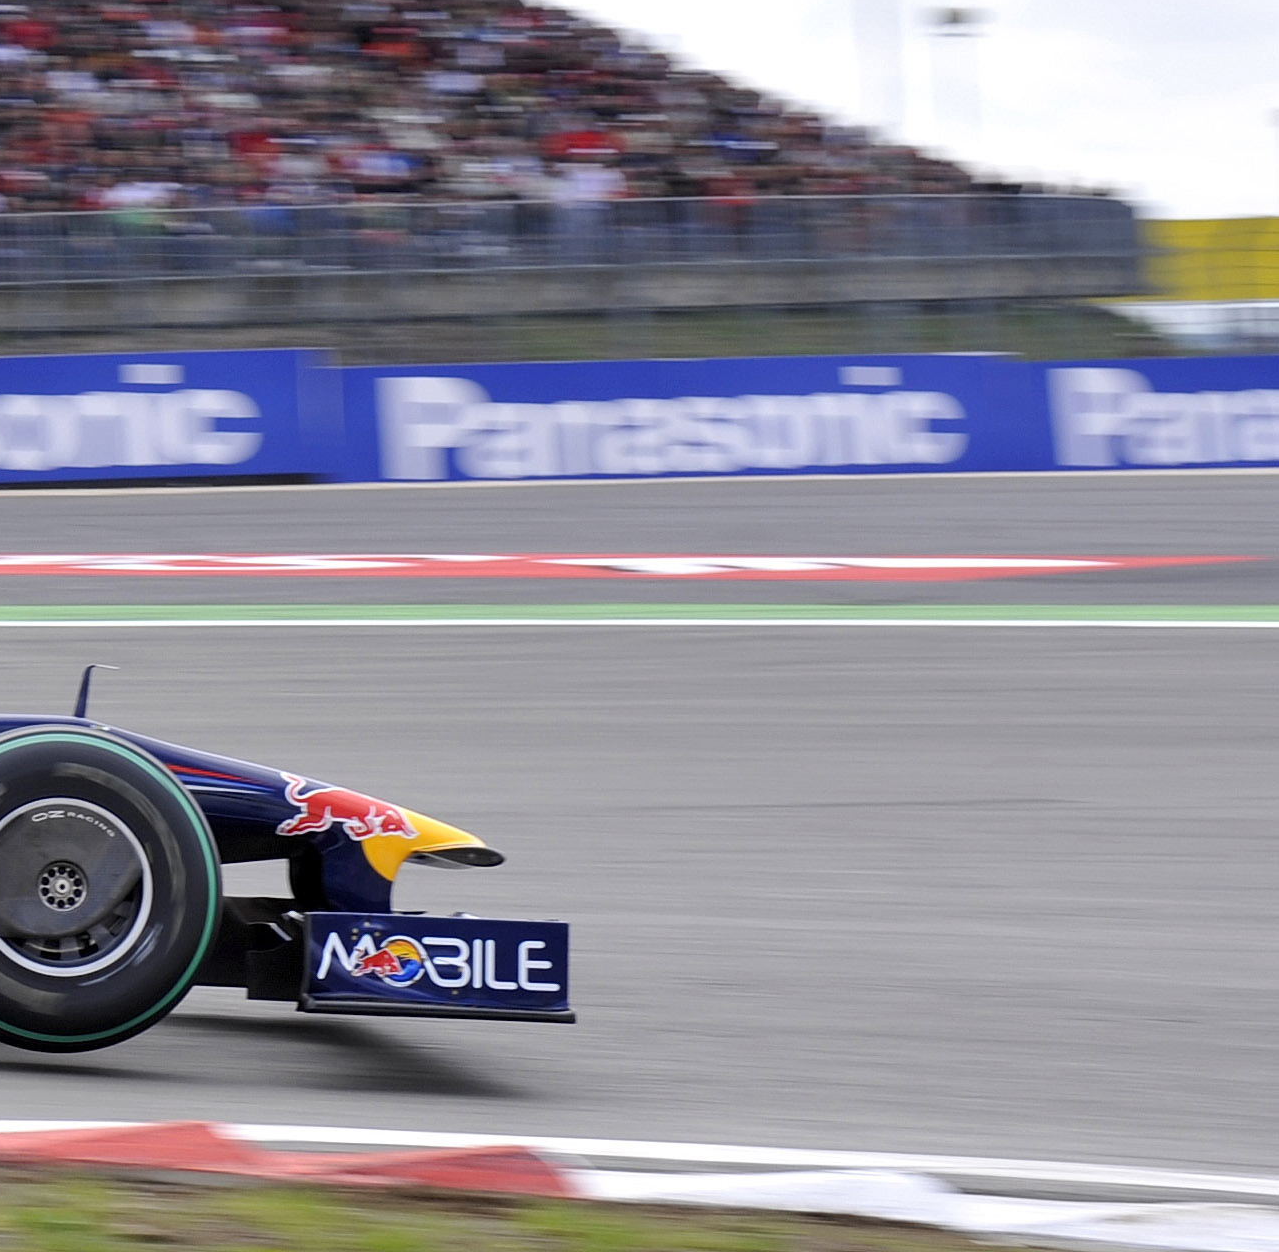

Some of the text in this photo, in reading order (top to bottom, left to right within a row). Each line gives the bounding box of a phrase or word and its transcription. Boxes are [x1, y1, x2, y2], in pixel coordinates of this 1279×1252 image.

[375, 366, 969, 480] Panasonic
[31, 810, 65, 822] OZ
[316, 932, 560, 992] MOBILE
